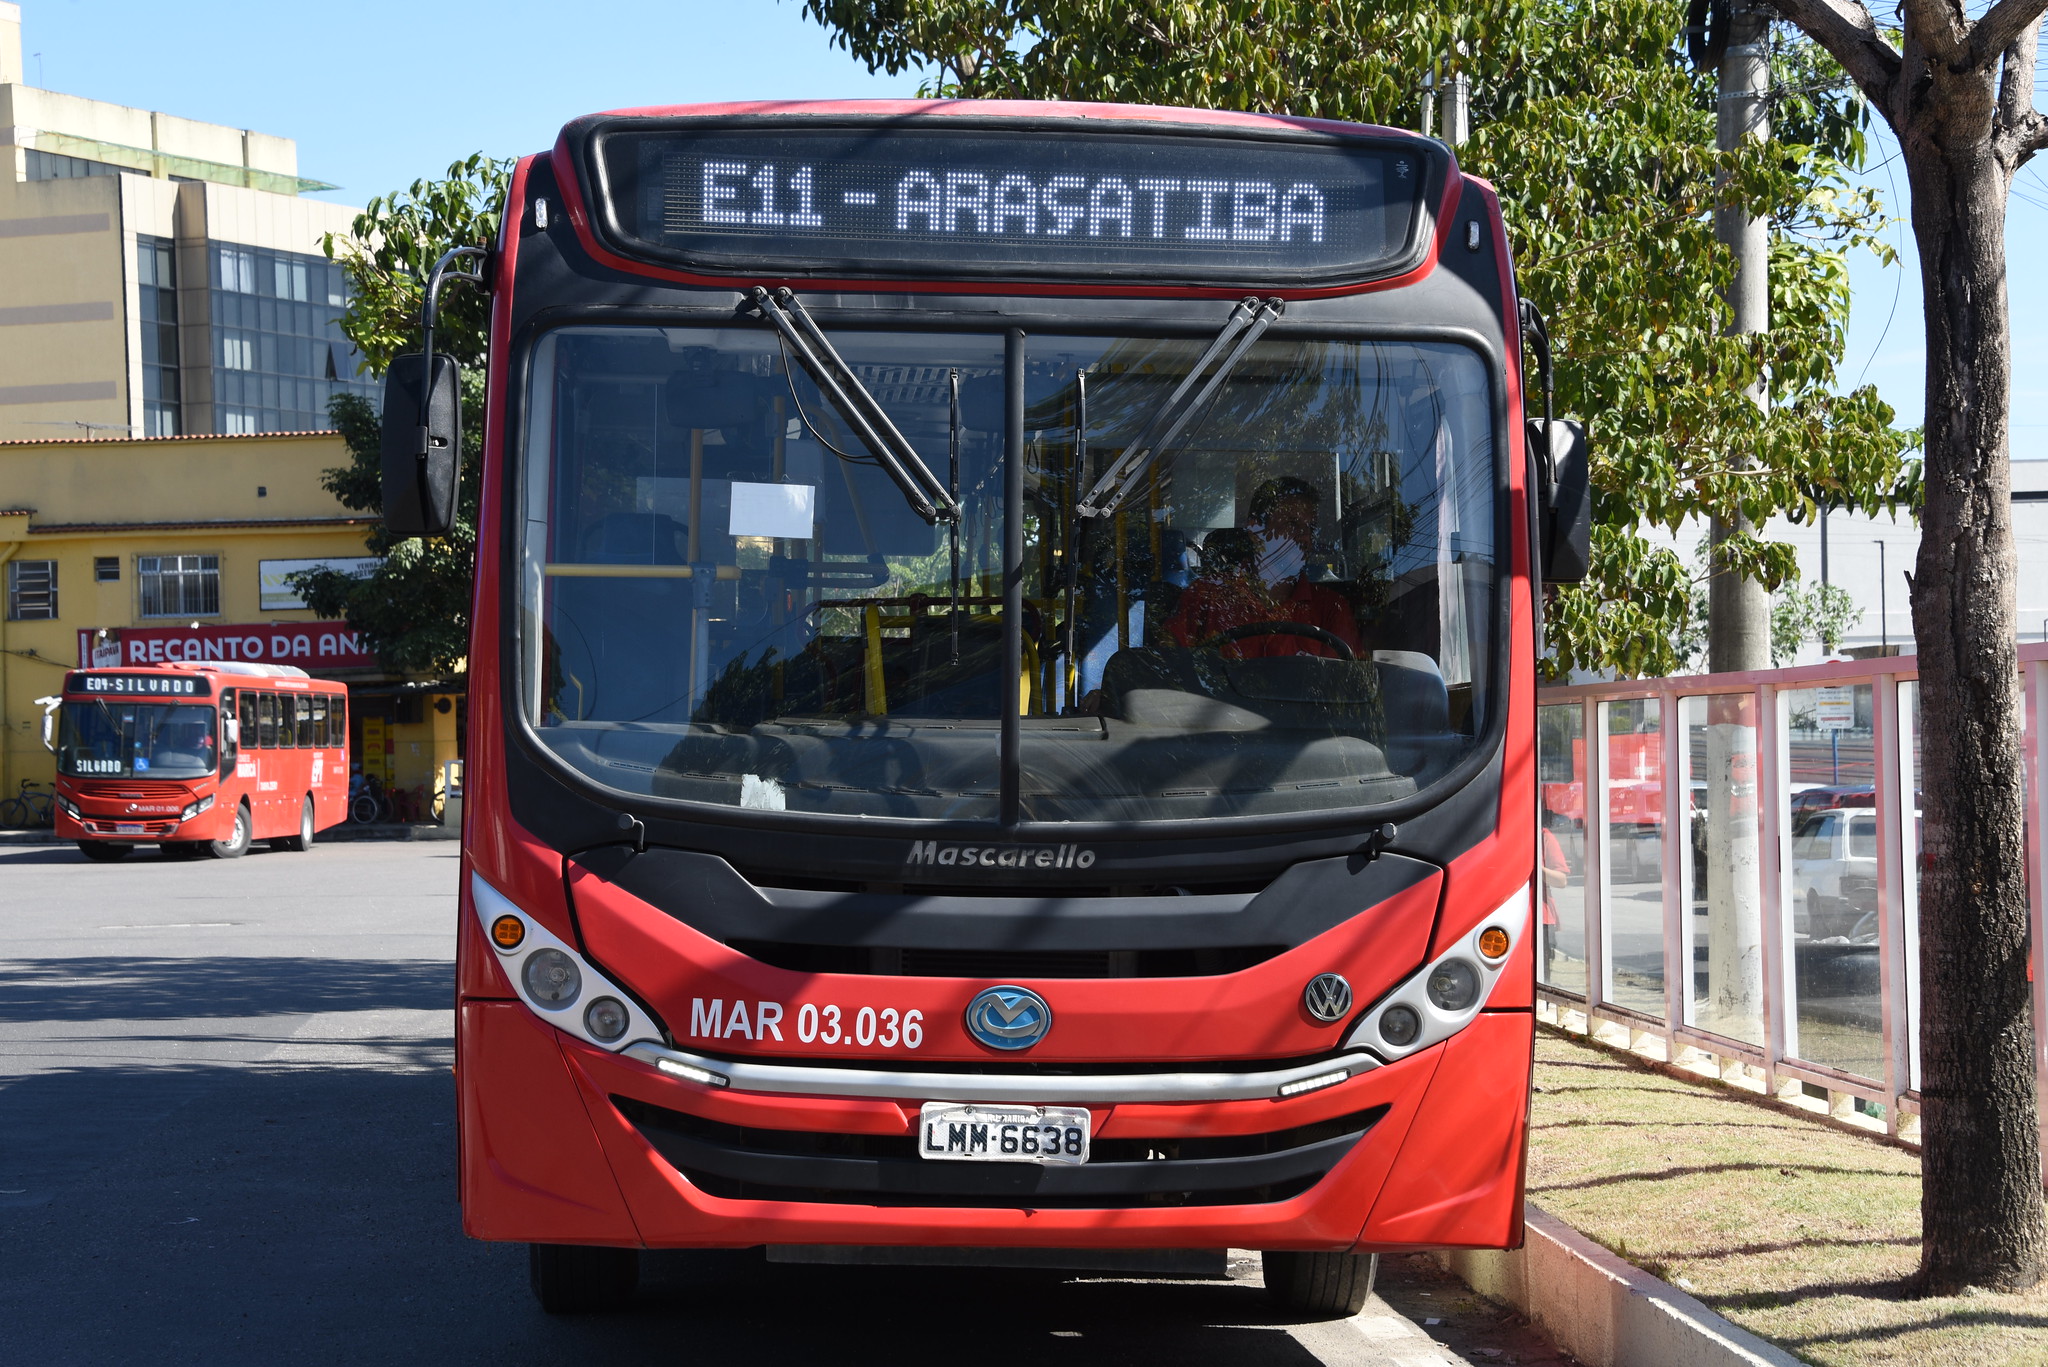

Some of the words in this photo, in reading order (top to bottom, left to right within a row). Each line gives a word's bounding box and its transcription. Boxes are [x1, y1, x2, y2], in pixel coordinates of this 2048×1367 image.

[703, 162, 822, 226] E11
[129, 635, 264, 662] RECANTO
[271, 634, 311, 659] DA
[906, 840, 1096, 869] Mascarello
[690, 997, 784, 1042] MAR
[797, 1003, 924, 1049] 03.036
